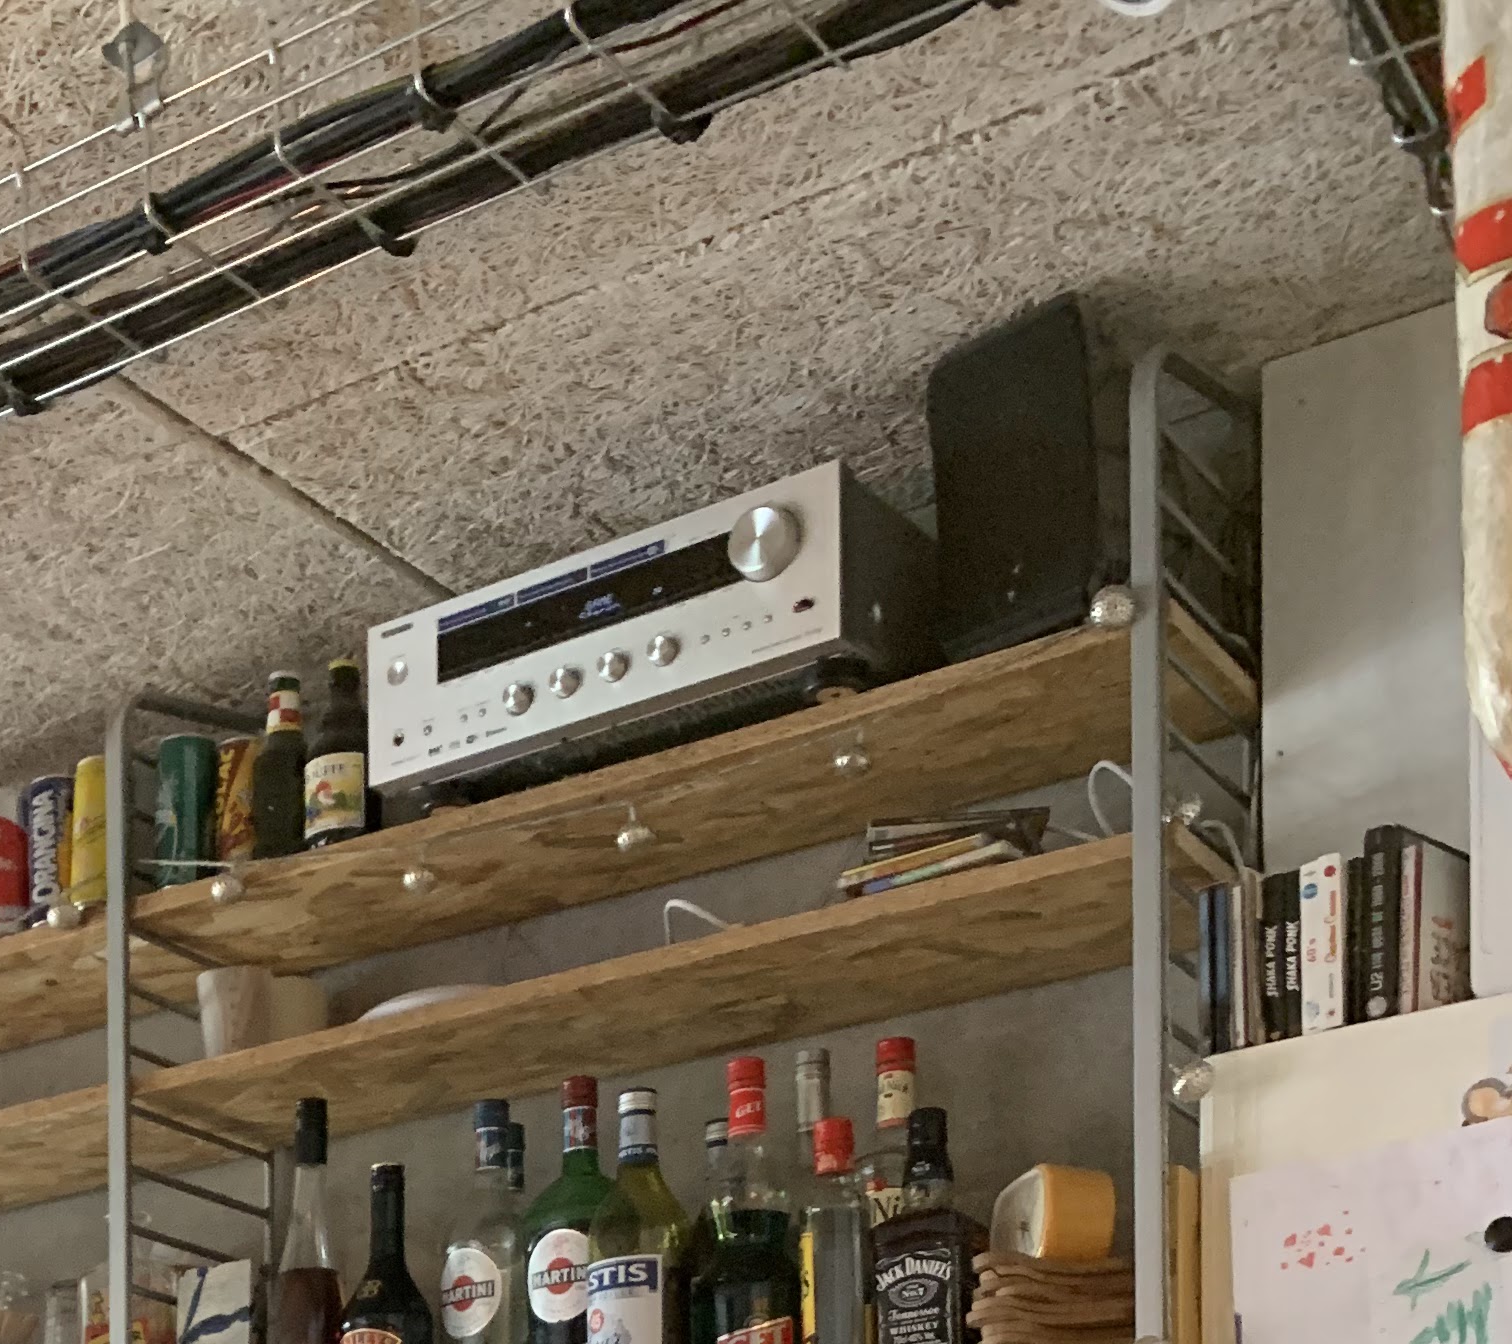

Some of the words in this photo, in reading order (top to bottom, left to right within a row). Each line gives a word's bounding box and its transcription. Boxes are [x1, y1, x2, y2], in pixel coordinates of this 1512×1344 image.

[32, 789, 60, 904] ORANGINA
[1285, 920, 1300, 952] PONK
[1265, 961, 1279, 997] SHAKA
[1286, 955, 1300, 991] SHAKA
[533, 1265, 588, 1287] MARTIN
[876, 1264, 904, 1291] JACK
[904, 1257, 951, 1280] DANIEL'S
[890, 1321, 938, 1335] WHISKEY
